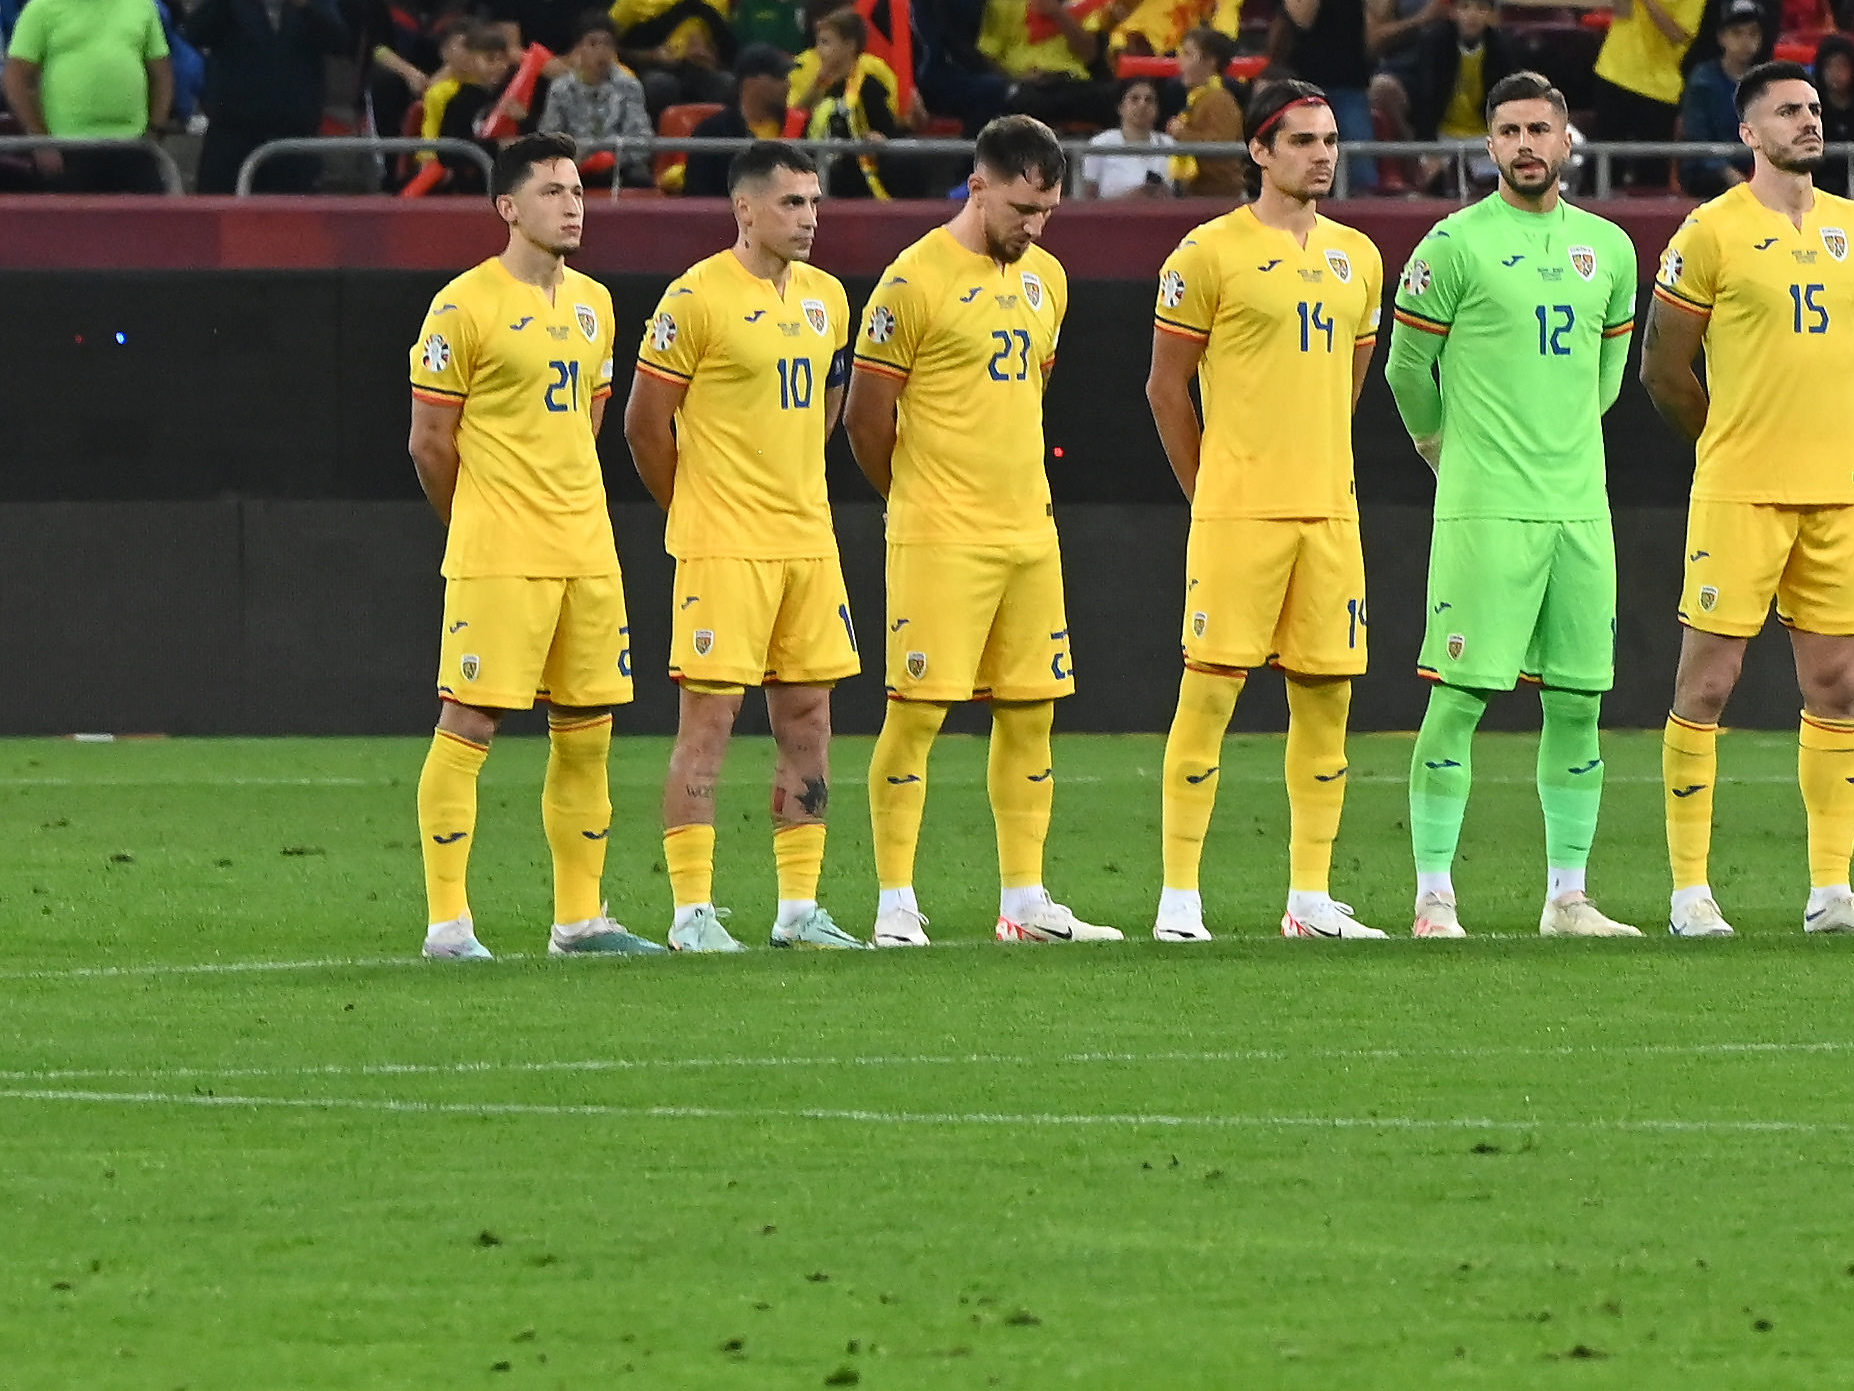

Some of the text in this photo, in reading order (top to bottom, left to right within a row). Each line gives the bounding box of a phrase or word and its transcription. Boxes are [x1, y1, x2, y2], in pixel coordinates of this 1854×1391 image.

[1297, 301, 1334, 354] 14
[1534, 304, 1576, 356] 12
[1789, 284, 1830, 334] 15
[988, 329, 1032, 381] 23
[544, 360, 580, 412] 21
[777, 358, 813, 410] 10
